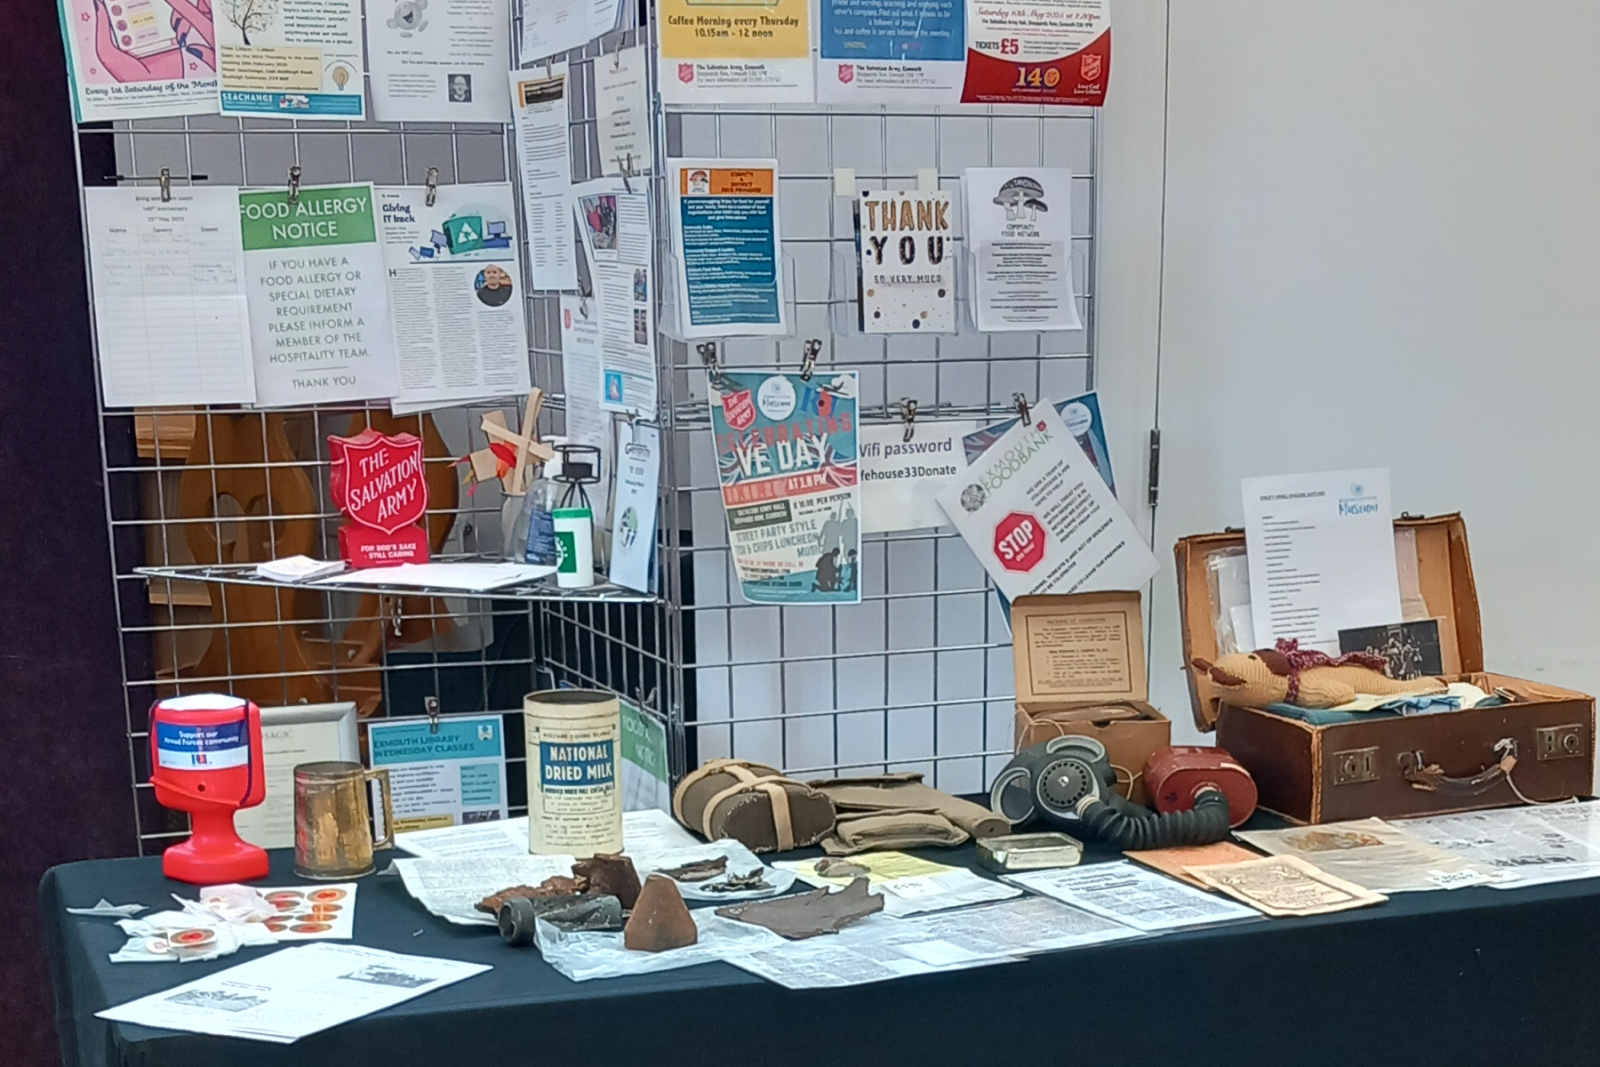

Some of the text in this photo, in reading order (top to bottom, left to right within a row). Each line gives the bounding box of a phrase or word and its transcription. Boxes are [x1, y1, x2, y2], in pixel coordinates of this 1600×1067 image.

[976, 7, 1009, 18] Saturday
[668, 15, 799, 28] Coffee Morning every Thursday
[694, 28, 729, 38] 10.15am
[739, 28, 749, 37] 12
[751, 29, 774, 37] noon
[975, 41, 1000, 50] TICKETS
[1000, 38, 1019, 54] £5
[1015, 67, 1060, 87] 140
[85, 88, 108, 96] Every
[125, 85, 162, 93] Saturday
[222, 92, 273, 102] SEACHANGE
[295, 197, 367, 217] ALLERGY
[382, 203, 411, 214] Giving
[383, 214, 416, 223] IT back
[865, 200, 949, 231] THANK
[272, 221, 338, 240] NOTICE
[869, 235, 944, 265] YOU
[268, 256, 349, 270] IF YOU HAVE A
[260, 270, 362, 287] FOOD ALLERGY OR
[874, 274, 942, 284] SO VERY MUCH
[269, 287, 356, 302] SPECIAL DIETARY
[276, 302, 353, 317] REQUIREMENT
[268, 317, 365, 333] PLEASE INFORM A
[275, 332, 362, 348] MEMBER OF THE
[269, 348, 371, 363] HOSPITALITY TEAM.
[291, 376, 356, 389] THANK YOU
[726, 399, 751, 421] SALVATION
[736, 433, 828, 476] VE DAY
[884, 436, 952, 459] password
[359, 448, 389, 478] THE
[979, 427, 1042, 488] EXMOUTH
[984, 431, 1053, 497] FOODBANK
[350, 450, 419, 511] SALVATION
[860, 465, 957, 481] fehouse33Donate
[788, 477, 798, 490] AT
[1052, 480, 1063, 491] HELP
[377, 478, 417, 523] ARMY
[829, 492, 851, 502] PERSON
[1061, 490, 1073, 502] TREAT
[1076, 494, 1091, 509] EXPECT
[1059, 497, 1077, 514] RESPECT
[1338, 503, 1378, 515] Museum
[760, 525, 786, 538] PARTY
[790, 519, 817, 533] STYLE
[1064, 518, 1075, 529] SAME
[998, 519, 1034, 561] STOP
[1061, 526, 1078, 542] RESPECT
[376, 544, 397, 552] GOD'S
[753, 540, 773, 553] CHIPS
[775, 532, 820, 549] LUNCHEON
[388, 550, 414, 558] CARING
[179, 731, 205, 739] Support
[182, 738, 204, 746] Forces
[205, 736, 239, 746] community
[374, 735, 460, 749] EXMOUTH LIBRARY
[374, 742, 475, 758] WEDNESDAY CLASSES
[550, 743, 608, 761] NATIONAL
[545, 763, 613, 781] DRIED MILK
